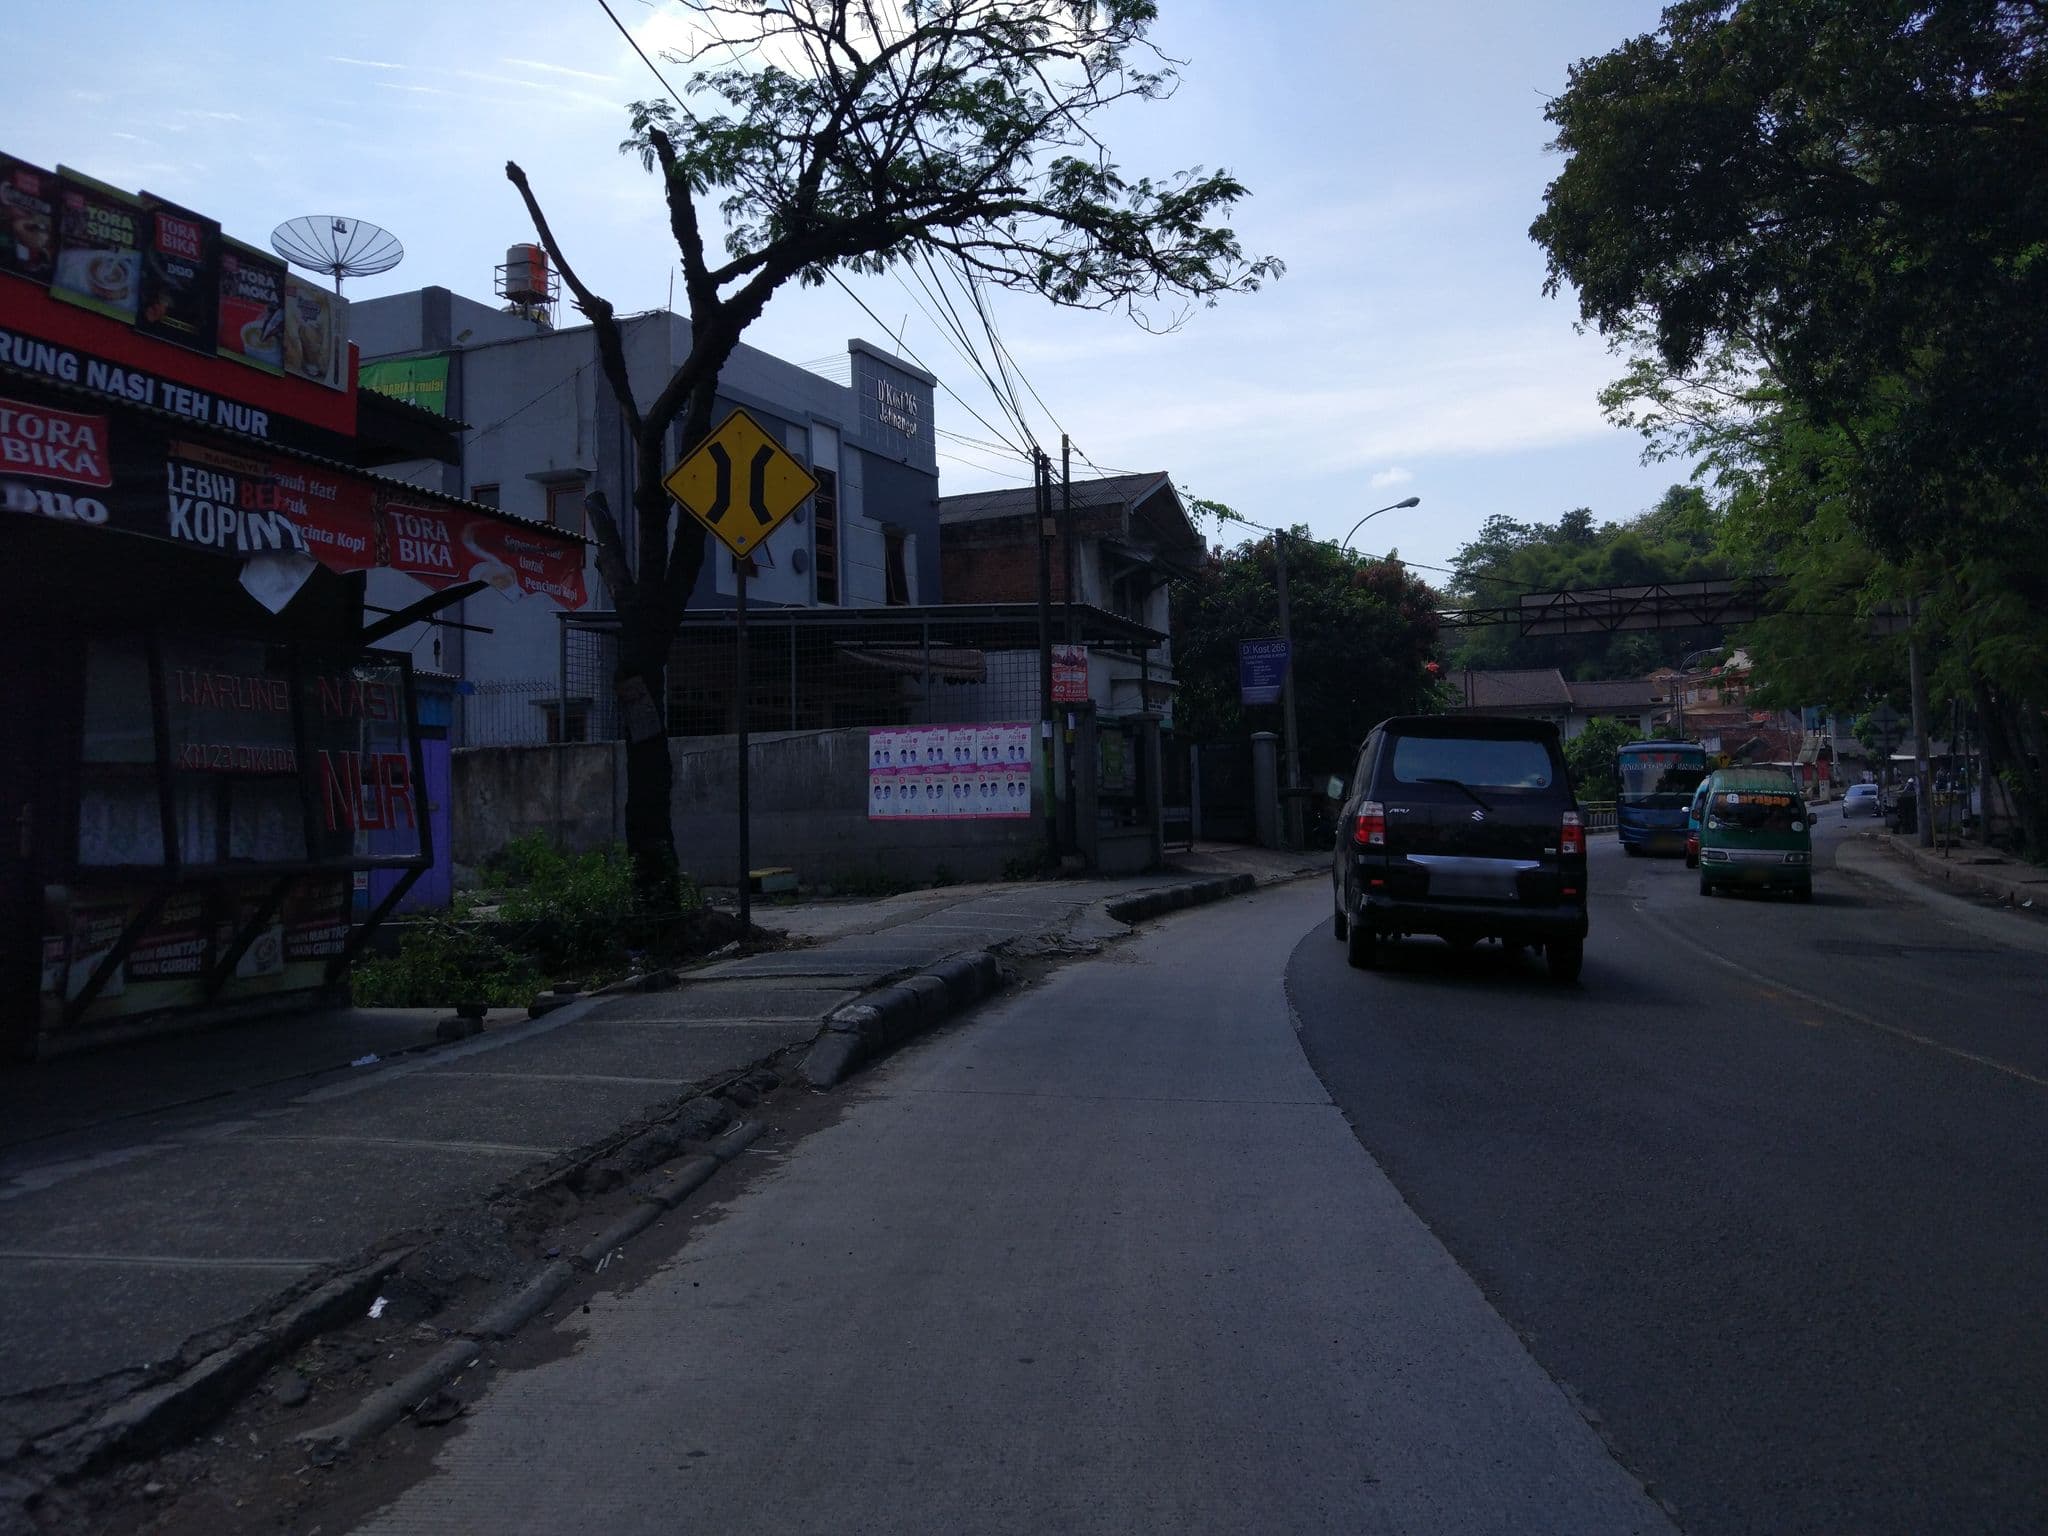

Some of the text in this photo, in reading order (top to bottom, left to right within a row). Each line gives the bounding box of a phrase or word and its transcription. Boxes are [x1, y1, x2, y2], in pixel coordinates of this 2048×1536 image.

[86, 222, 134, 246] SUSU
[87, 207, 134, 233] TORA
[158, 217, 198, 241] TORA
[161, 232, 199, 257] BIKA
[237, 282, 279, 302] MOKA
[239, 267, 276, 289] TORA
[0, 330, 270, 438] RUNG NASI TEH NUR
[0, 407, 97, 451] TORA
[1, 436, 101, 478] BIKA
[167, 461, 236, 504] LEBIH
[309, 479, 337, 500] Hati
[387, 511, 450, 543] TORA
[336, 532, 366, 553] Kopi
[399, 538, 453, 568] BIKA
[317, 675, 400, 721] NASI
[318, 750, 416, 832] NUR
